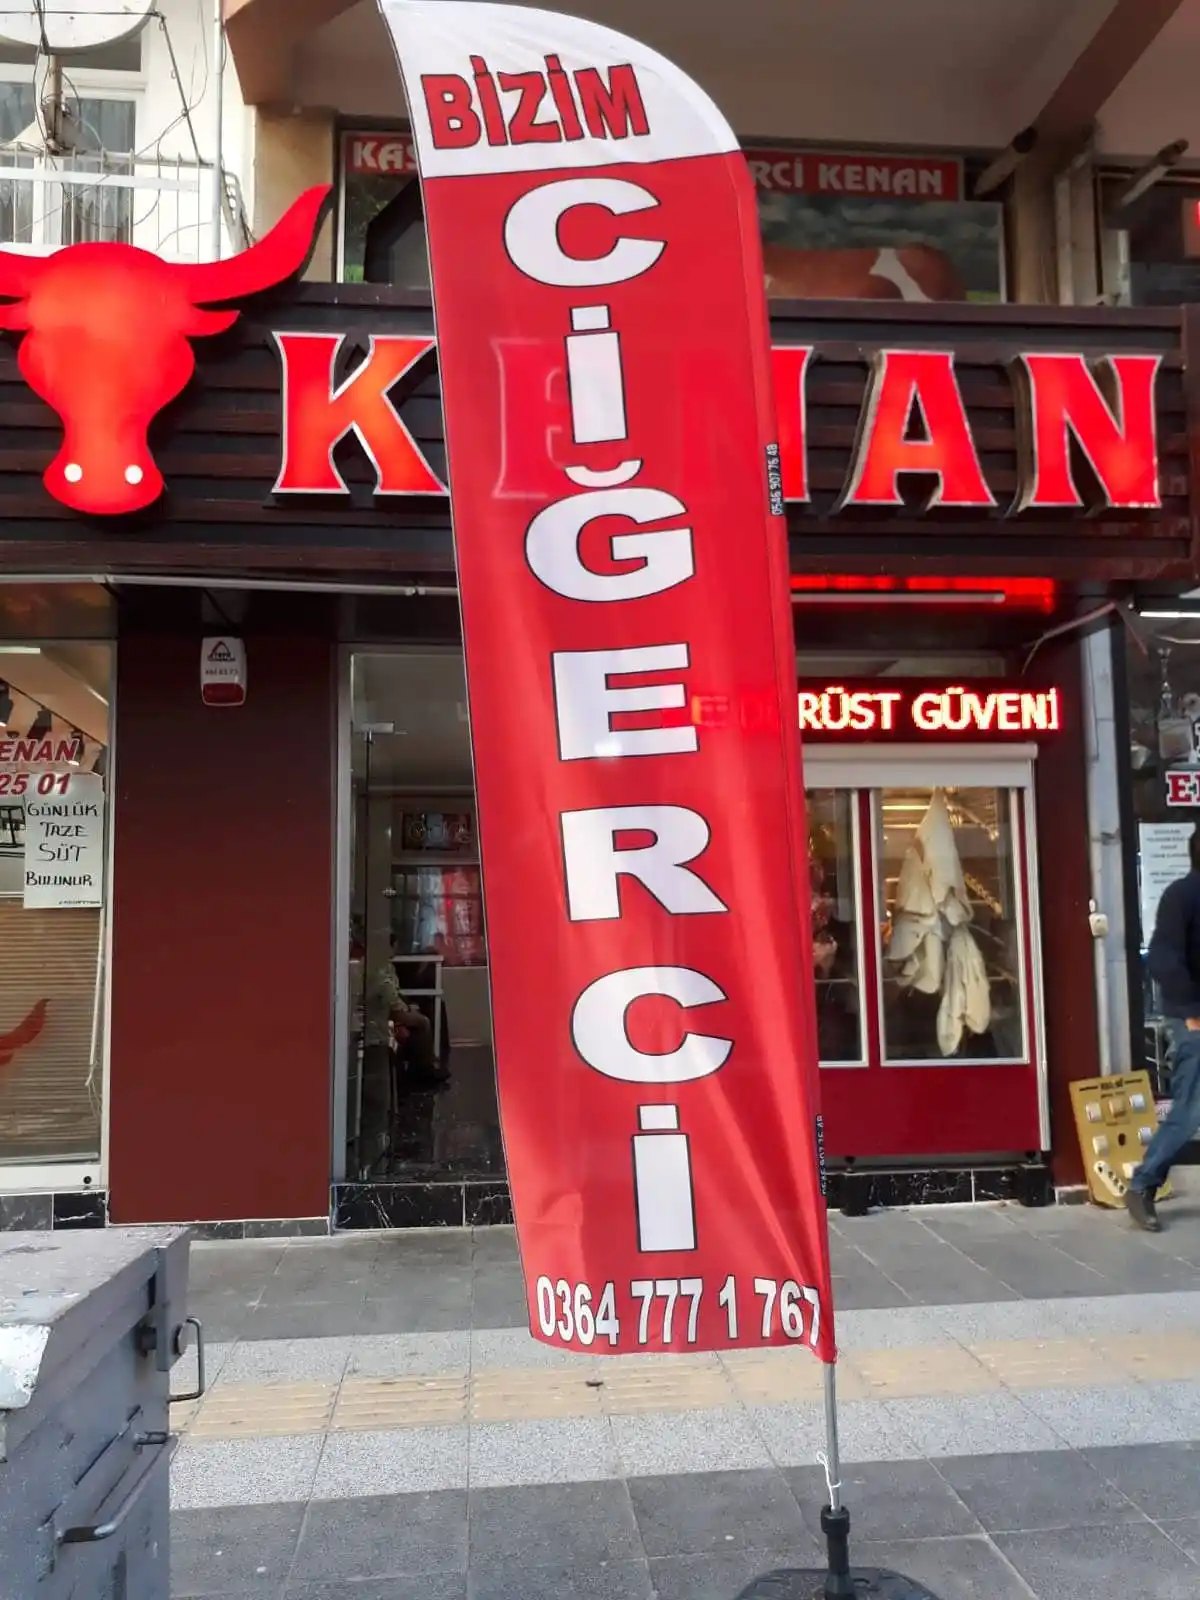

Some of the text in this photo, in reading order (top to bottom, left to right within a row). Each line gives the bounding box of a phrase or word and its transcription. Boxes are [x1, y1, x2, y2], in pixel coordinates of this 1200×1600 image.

[420, 54, 650, 149] BİZİM
[818, 162, 943, 195] KENAN
[503, 177, 734, 1253] CİĞERCİ
[912, 686, 1059, 730] GÜVENİ
[37, 772, 72, 796] 01
[27, 801, 98, 817] GÜNLÜK
[39, 821, 88, 838] TAZE
[36, 842, 88, 862] SÜT
[26, 871, 93, 887] BULUNUR
[536, 1275, 820, 1347] 0364 777 1 767
